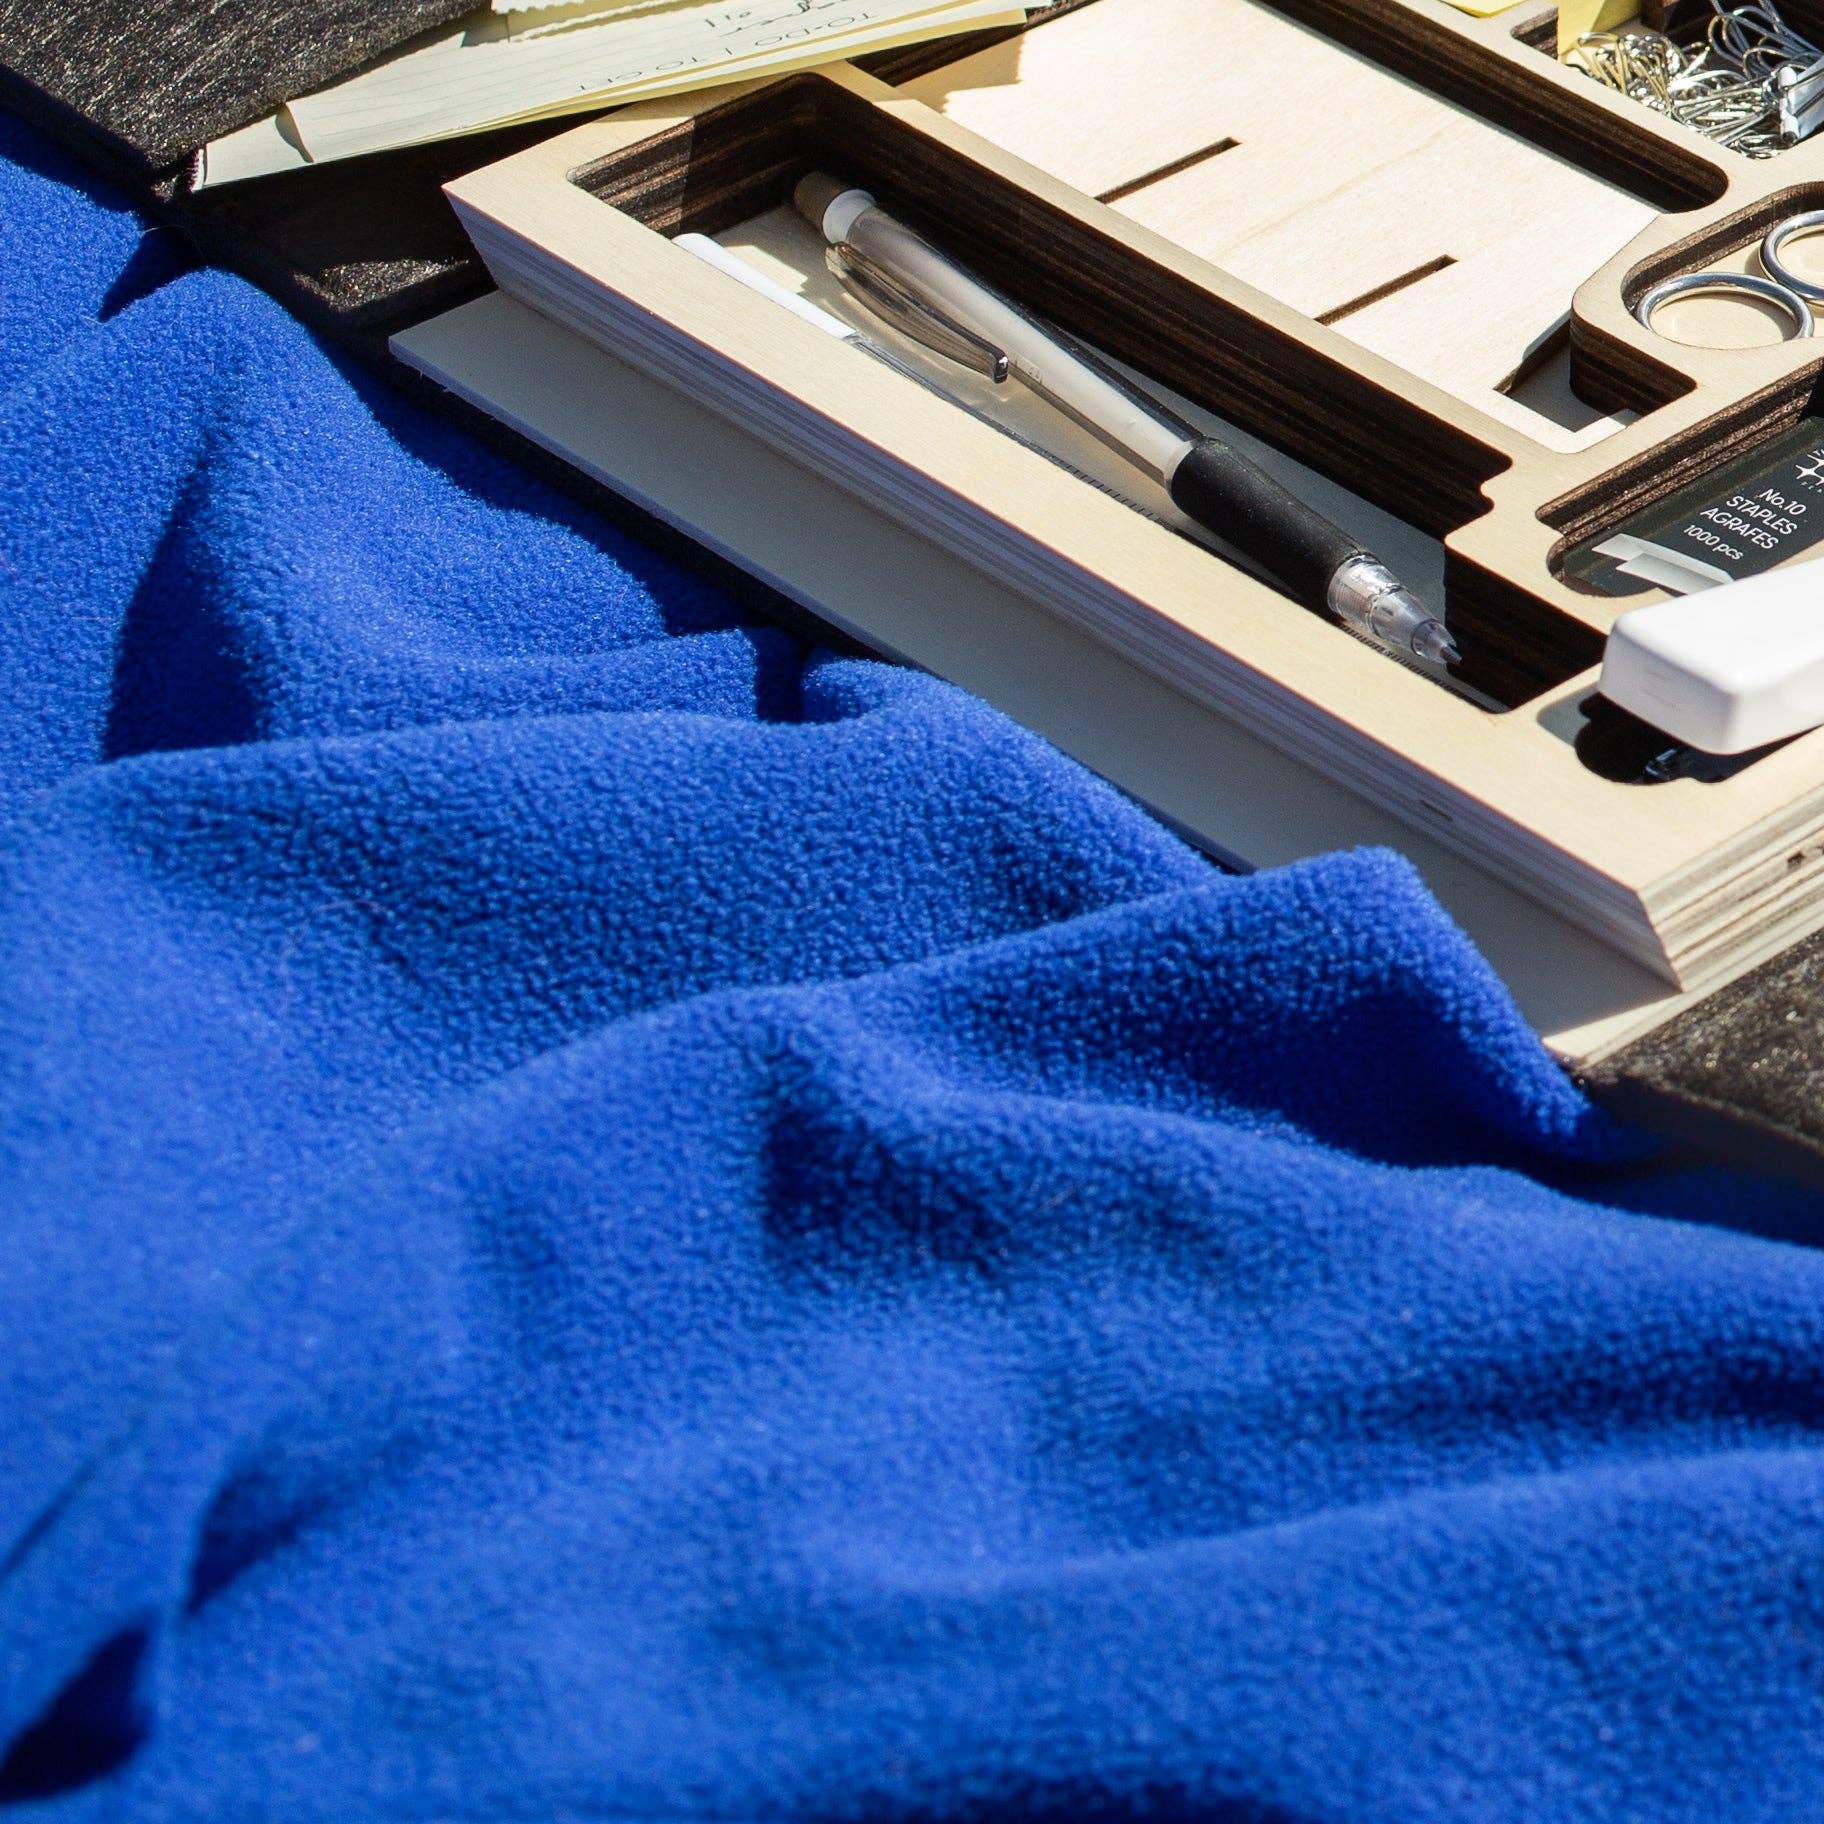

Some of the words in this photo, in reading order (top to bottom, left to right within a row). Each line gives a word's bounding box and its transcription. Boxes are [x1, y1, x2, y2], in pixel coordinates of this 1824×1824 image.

[1726, 495, 1798, 536] STAPLES
[1759, 488, 1807, 516] No.10
[1683, 524, 1715, 546] 1000
[1712, 540, 1744, 561] pcs
[1699, 507, 1780, 550] AGRAFES
